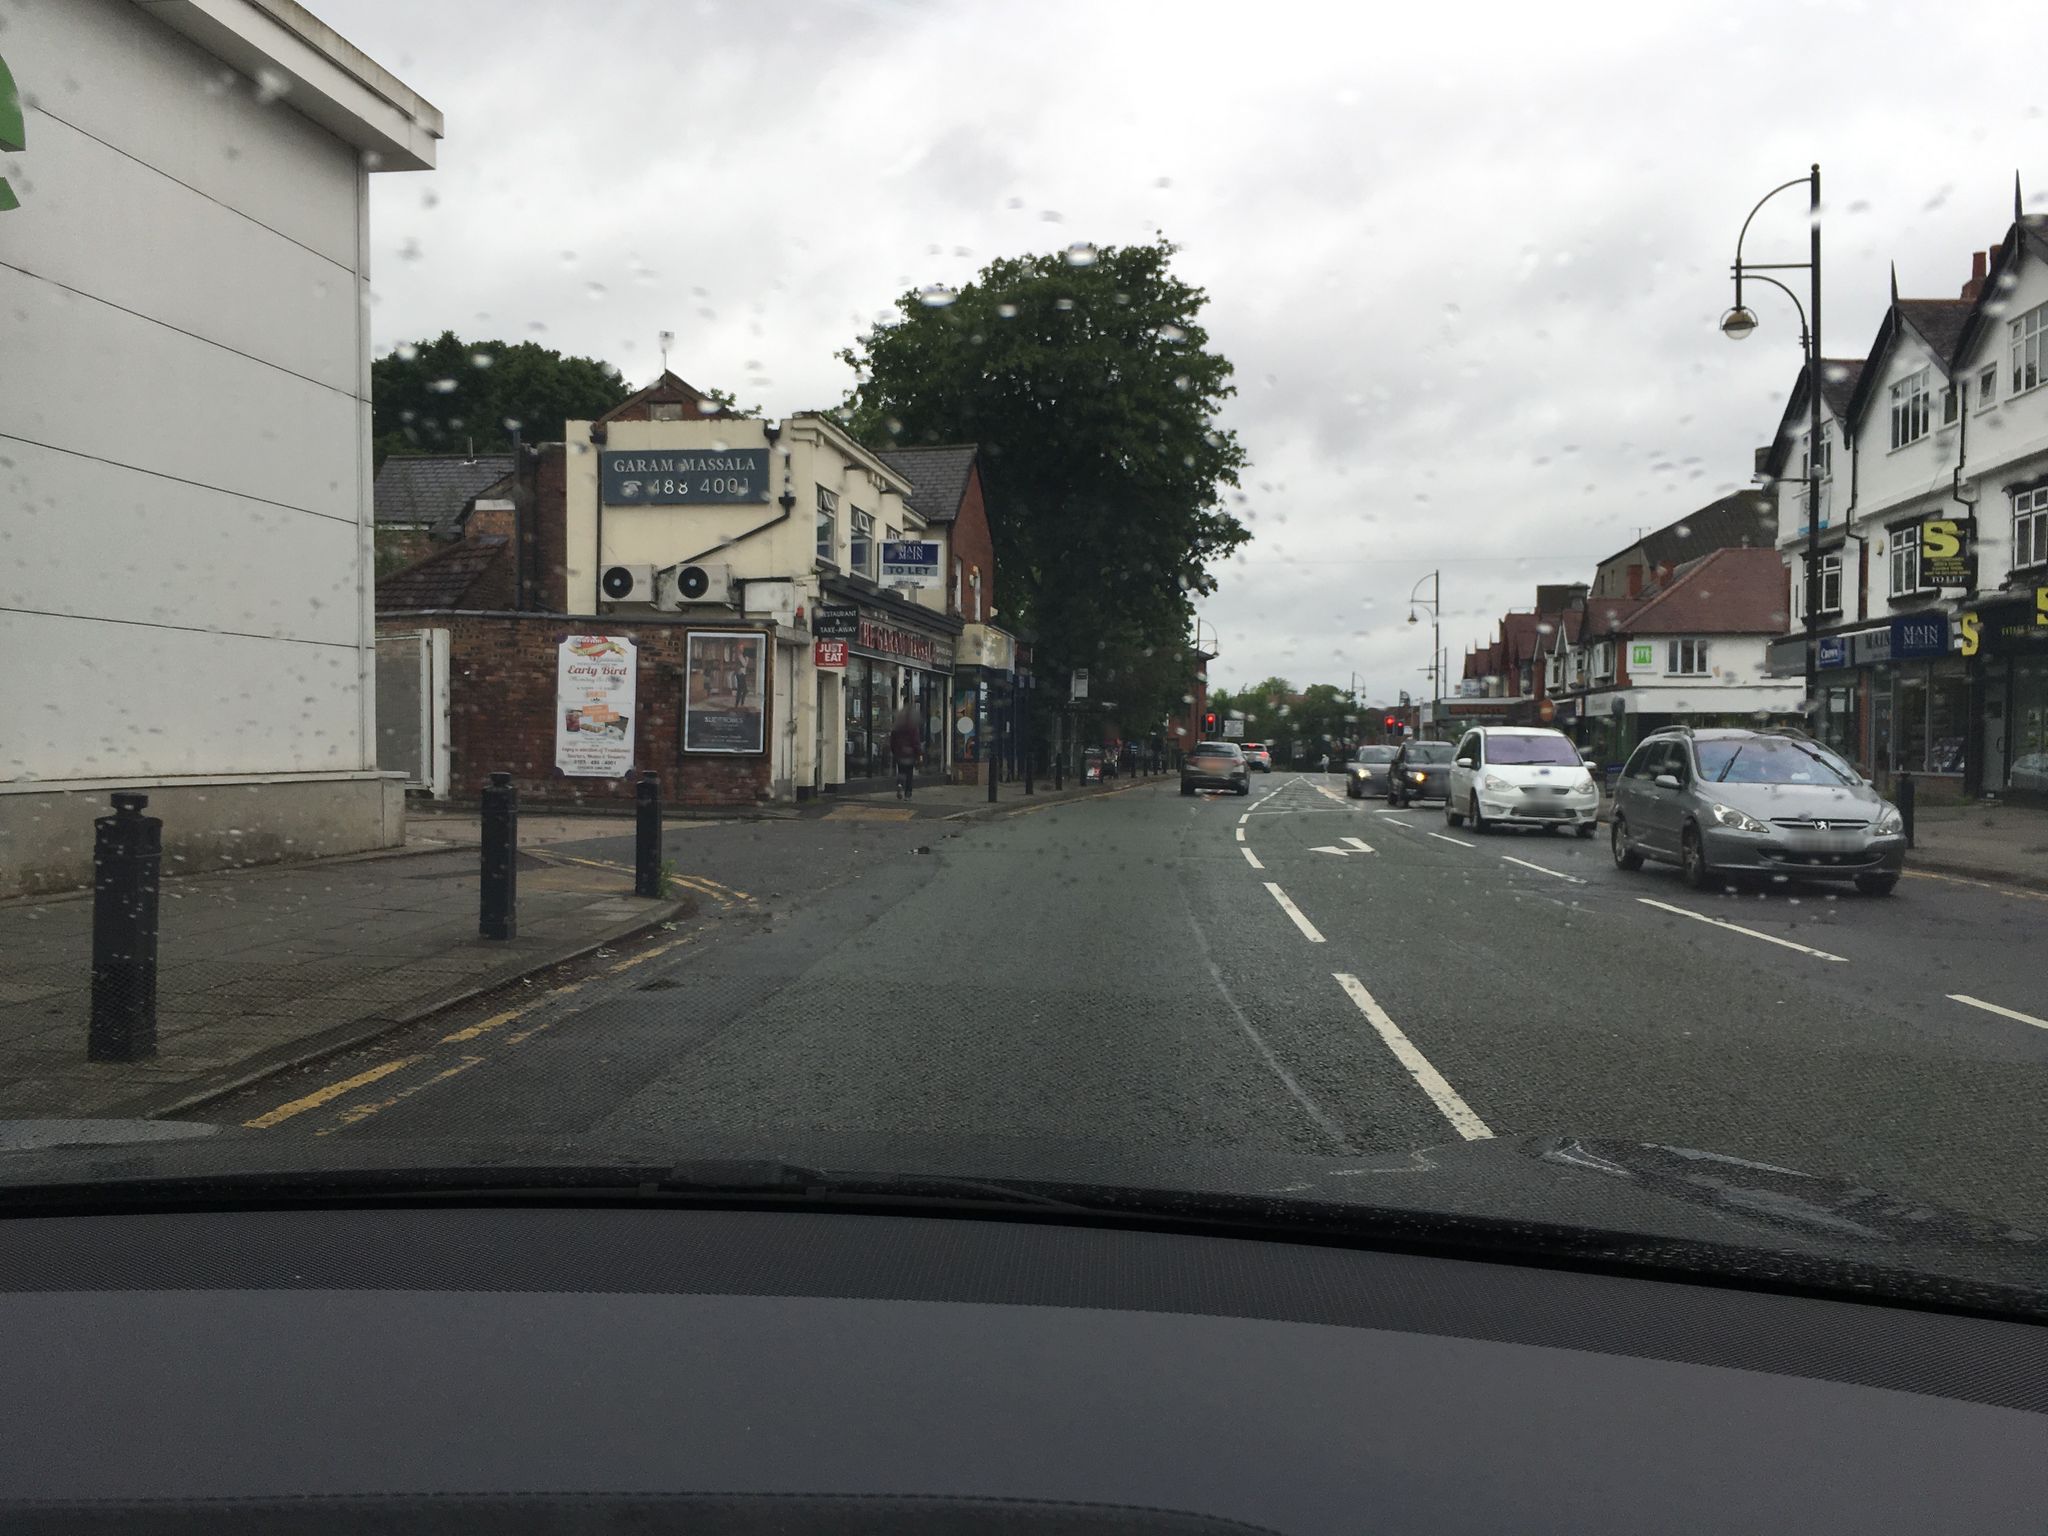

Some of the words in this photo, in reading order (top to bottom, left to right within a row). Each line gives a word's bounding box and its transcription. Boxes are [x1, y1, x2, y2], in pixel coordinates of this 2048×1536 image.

[613, 458, 674, 473] GARAM
[682, 457, 756, 472] MASSALA
[700, 477, 749, 495] 4001
[1923, 520, 1960, 558] S
[889, 566, 904, 575] TO
[908, 566, 929, 576] LET
[1903, 625, 1938, 636] MAIN
[818, 643, 843, 653] JUST
[824, 653, 843, 662] EAT
[567, 664, 598, 678] Early
[601, 665, 628, 676] Bird
